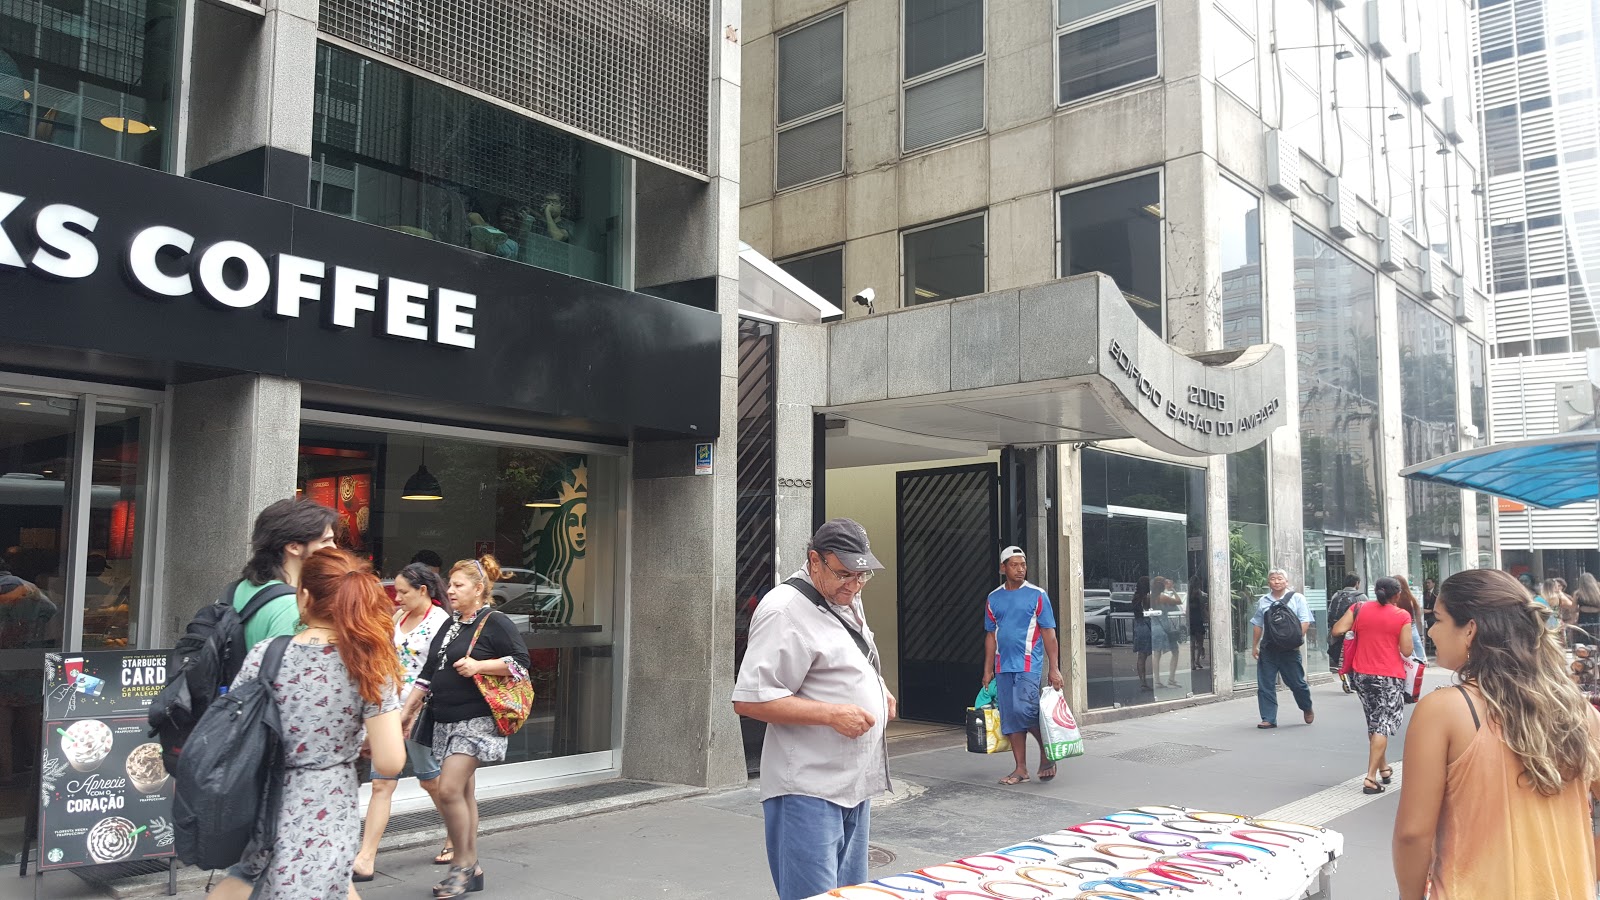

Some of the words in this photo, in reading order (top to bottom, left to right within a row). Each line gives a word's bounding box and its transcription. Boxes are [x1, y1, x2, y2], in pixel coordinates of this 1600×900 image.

[129, 226, 477, 349] COFFEE
[1166, 399, 1213, 435] BARÃO
[1215, 421, 1235, 436] DO
[1237, 396, 1281, 434] AMPARO
[778, 477, 812, 488] 2006
[122, 657, 167, 668] STARBUCKS
[121, 666, 166, 686] CARD
[66, 773, 126, 796] Aprecie
[66, 793, 125, 813] CORAÇÃO
